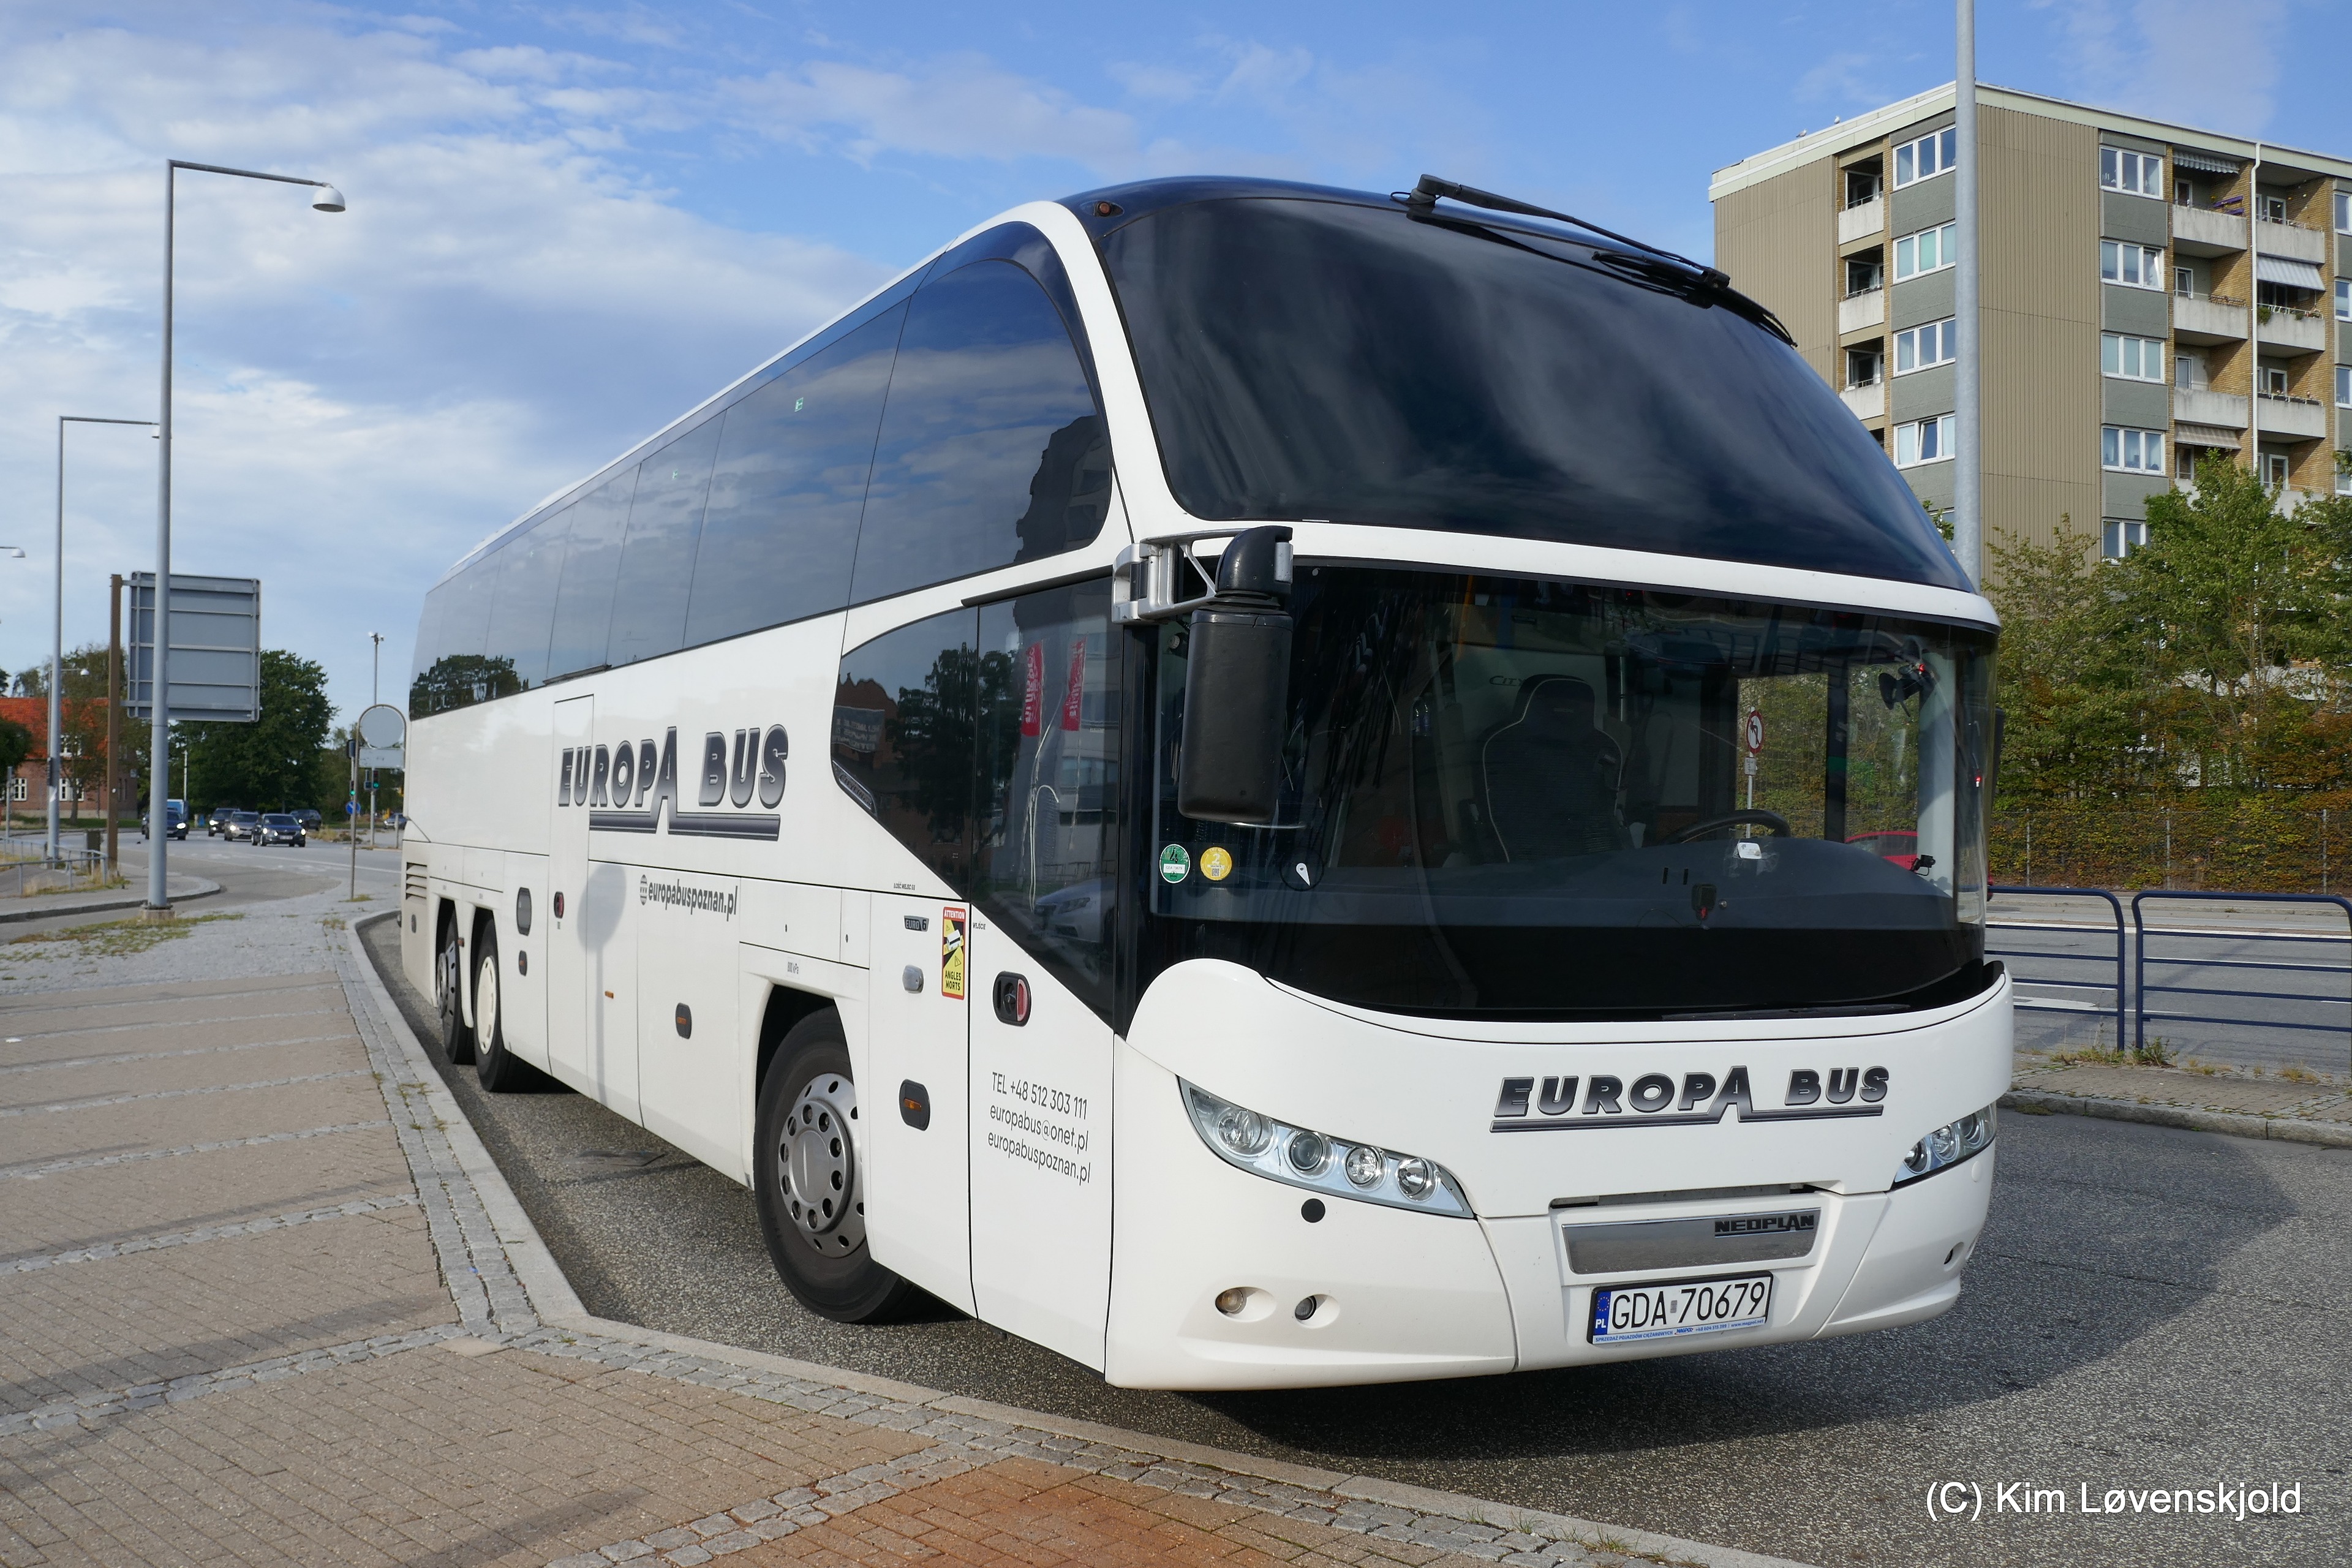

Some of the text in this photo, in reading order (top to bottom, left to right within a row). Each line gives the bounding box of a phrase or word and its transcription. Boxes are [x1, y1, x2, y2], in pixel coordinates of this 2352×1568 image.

[558, 724, 789, 821] EUROPA BUS
[1170, 846, 1178, 864] 4
[1212, 853, 1220, 864] 2
[648, 878, 738, 922] europabuspoznan.pl
[944, 910, 965, 920] ATTENTION
[905, 919, 927, 930] EURO 6
[945, 970, 962, 981] ANGLES
[945, 980, 960, 991] MORTS
[992, 1072, 1087, 1120] TEL +48 512 303 111
[1494, 1066, 1890, 1120] EUROPA BUS
[990, 1105, 1089, 1155] europabus@onet.pl
[988, 1132, 1091, 1186] europabuspoznan.pl
[1715, 1215, 1814, 1234] NEOPLAN
[1611, 1281, 1765, 1329] GDA 70679
[1595, 1318, 1606, 1329] PL
[1731, 1319, 1764, 1327] www.magpol.net
